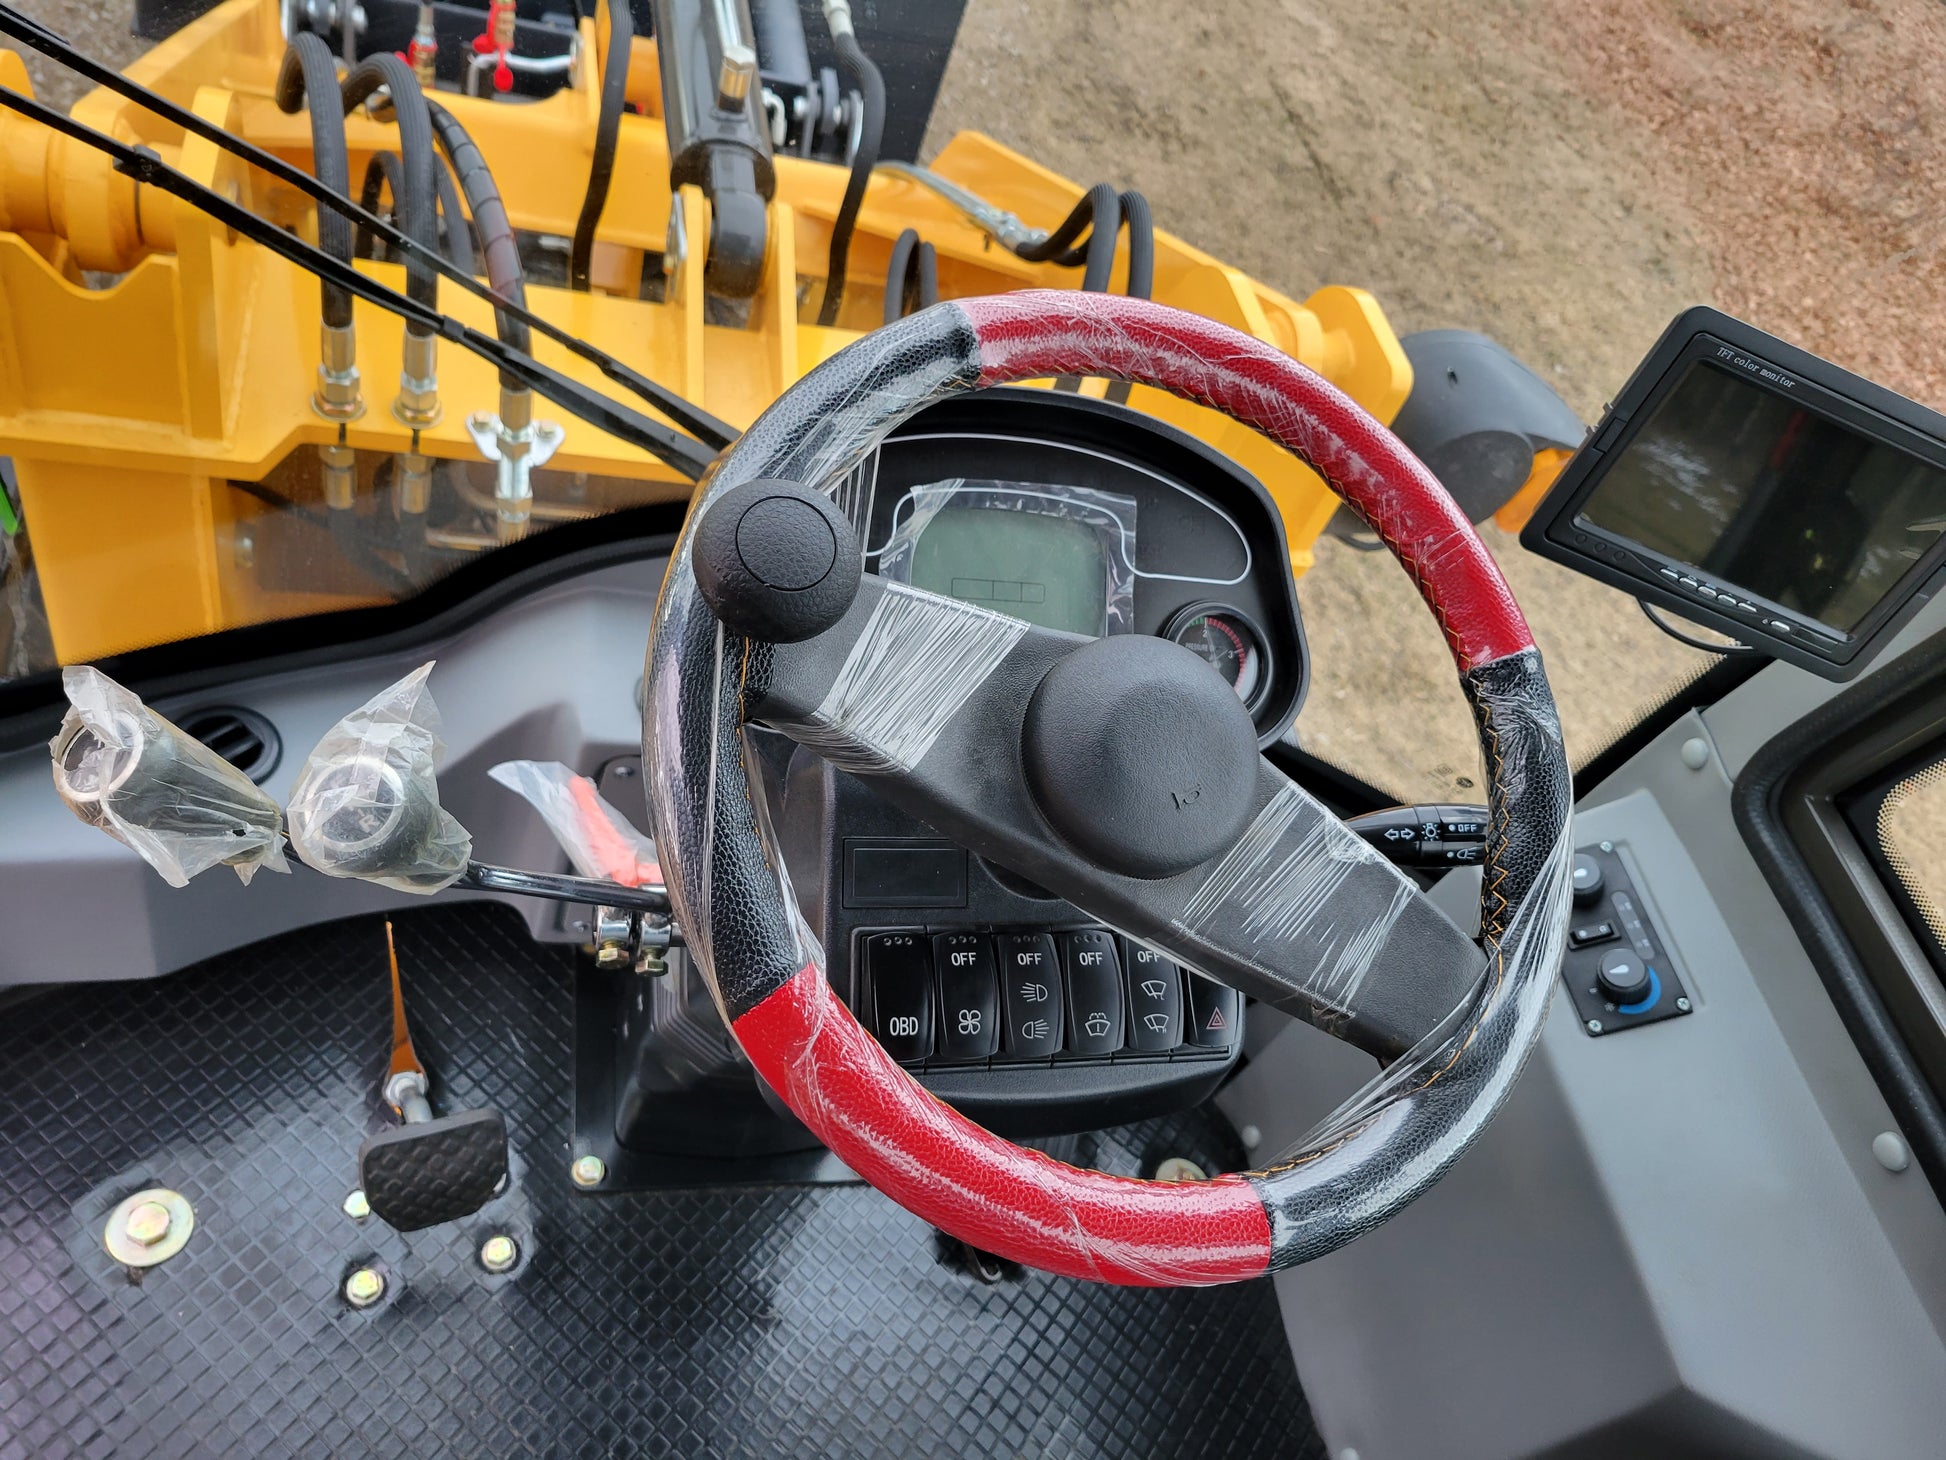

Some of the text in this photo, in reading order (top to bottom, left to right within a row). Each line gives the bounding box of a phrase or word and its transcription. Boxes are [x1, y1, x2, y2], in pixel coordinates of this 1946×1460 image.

[1717, 347, 1795, 388] TFT color monitor
[1227, 651, 1234, 659] 3
[1457, 824, 1478, 833] OFF
[951, 952, 976, 967] OFF
[1016, 952, 1042, 966] OFF
[1079, 952, 1103, 966] OFF
[889, 1017, 919, 1037] OBD
